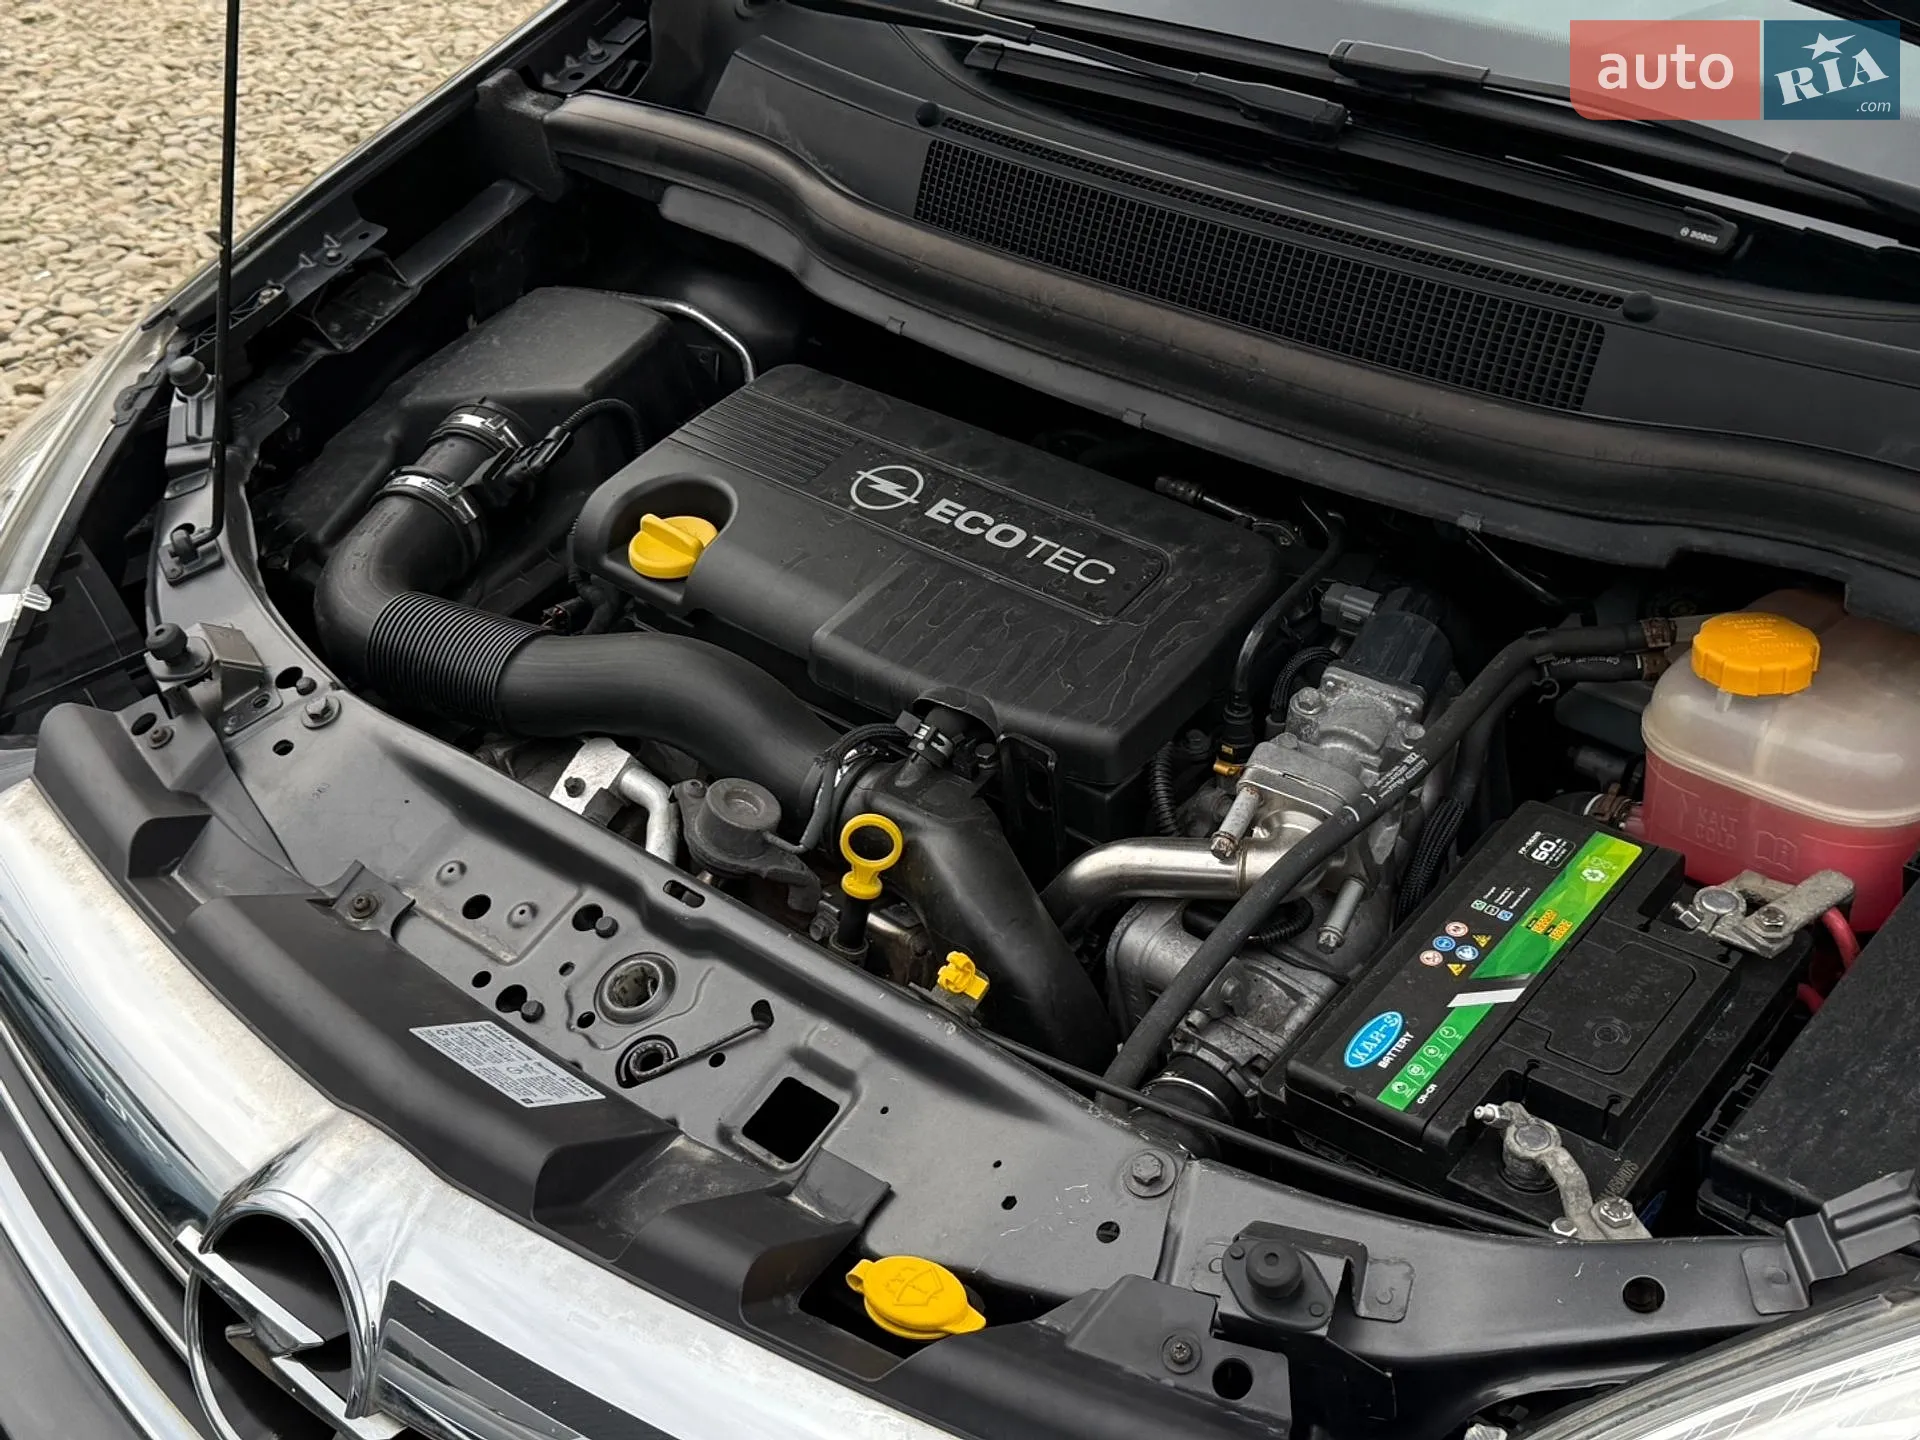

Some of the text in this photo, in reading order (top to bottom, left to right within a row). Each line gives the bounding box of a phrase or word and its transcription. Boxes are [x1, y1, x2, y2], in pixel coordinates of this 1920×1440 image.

[925, 498, 1116, 584] ECOTEC
[1531, 840, 1557, 861] 60
[1377, 1031, 1415, 1069] BATTERY
